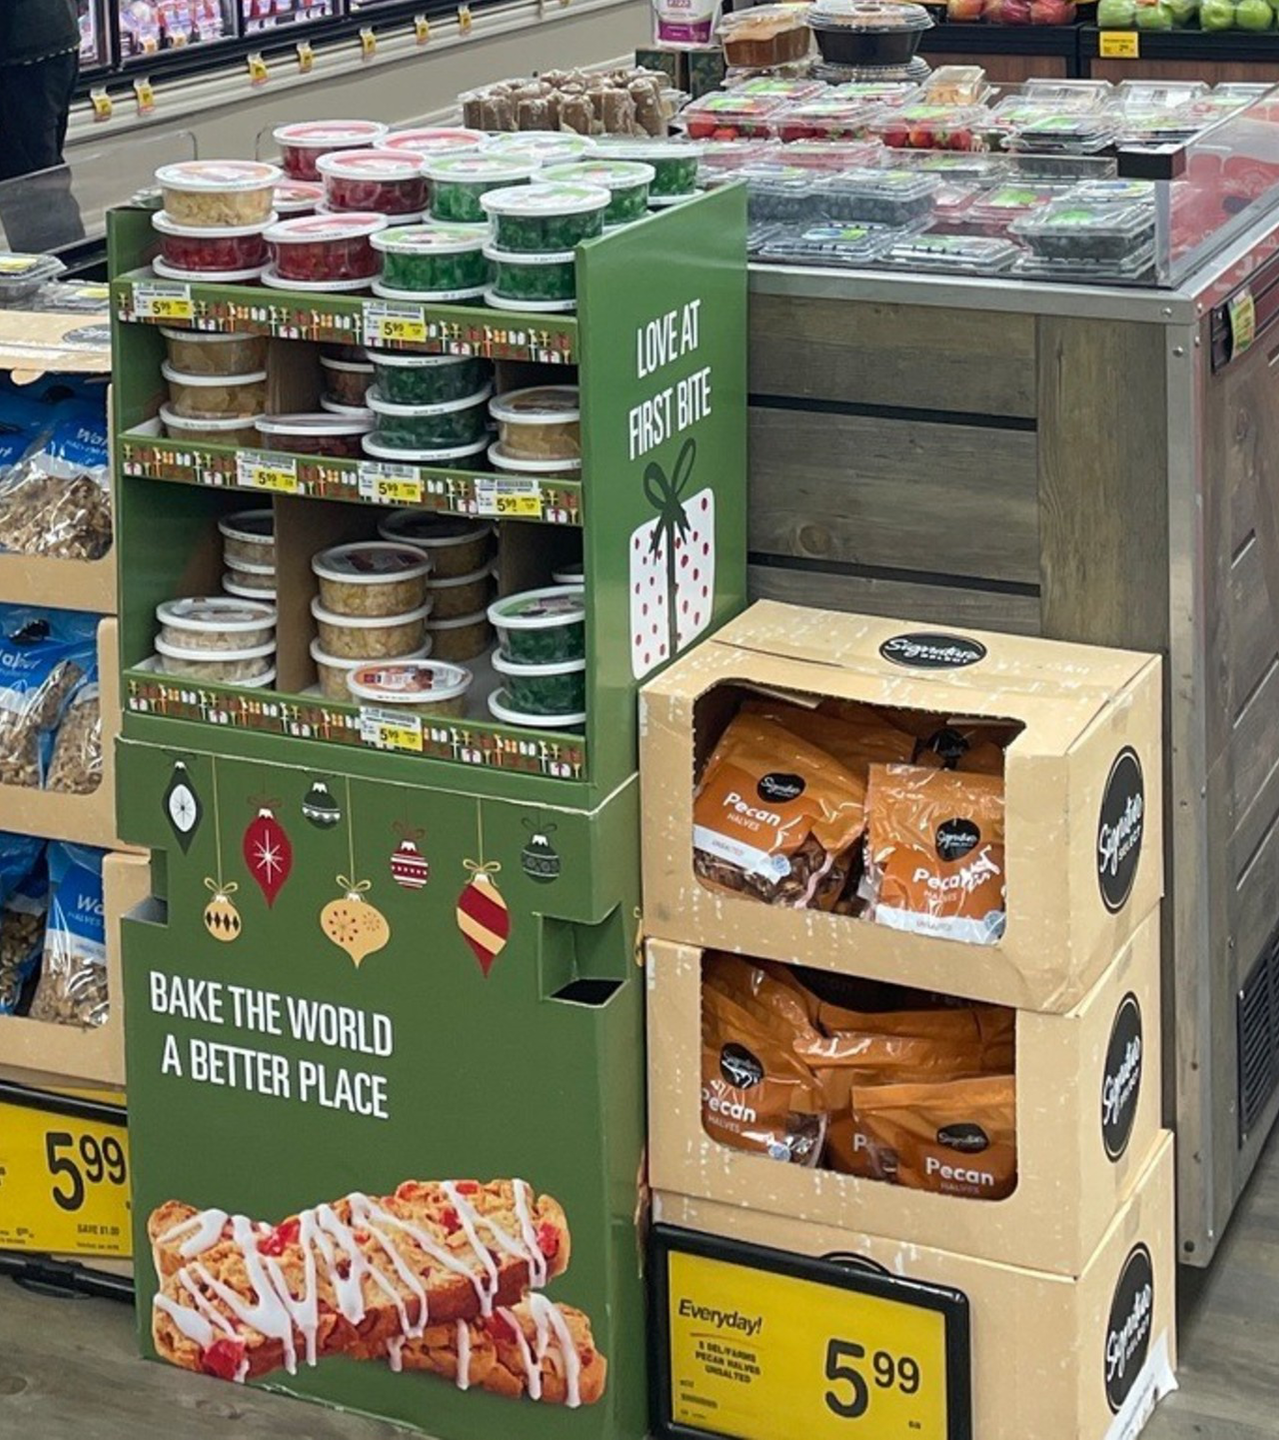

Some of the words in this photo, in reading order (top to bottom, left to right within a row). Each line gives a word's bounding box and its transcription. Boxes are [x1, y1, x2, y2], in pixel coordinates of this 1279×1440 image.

[637, 310, 678, 380] LOVE
[680, 298, 701, 355] AT
[629, 387, 673, 460] FIRST
[677, 366, 712, 433] BITE
[723, 791, 781, 827] Pecan
[727, 813, 761, 832] HALVES
[149, 970, 223, 1025] BAKE
[228, 985, 281, 1036] THE
[286, 996, 393, 1057] WORLD
[161, 1034, 182, 1076] A
[190, 1039, 290, 1099] BETTER
[299, 1063, 389, 1120] PLACE
[926, 1157, 994, 1185] Pecan
[678, 1298, 763, 1336] Everyday!
